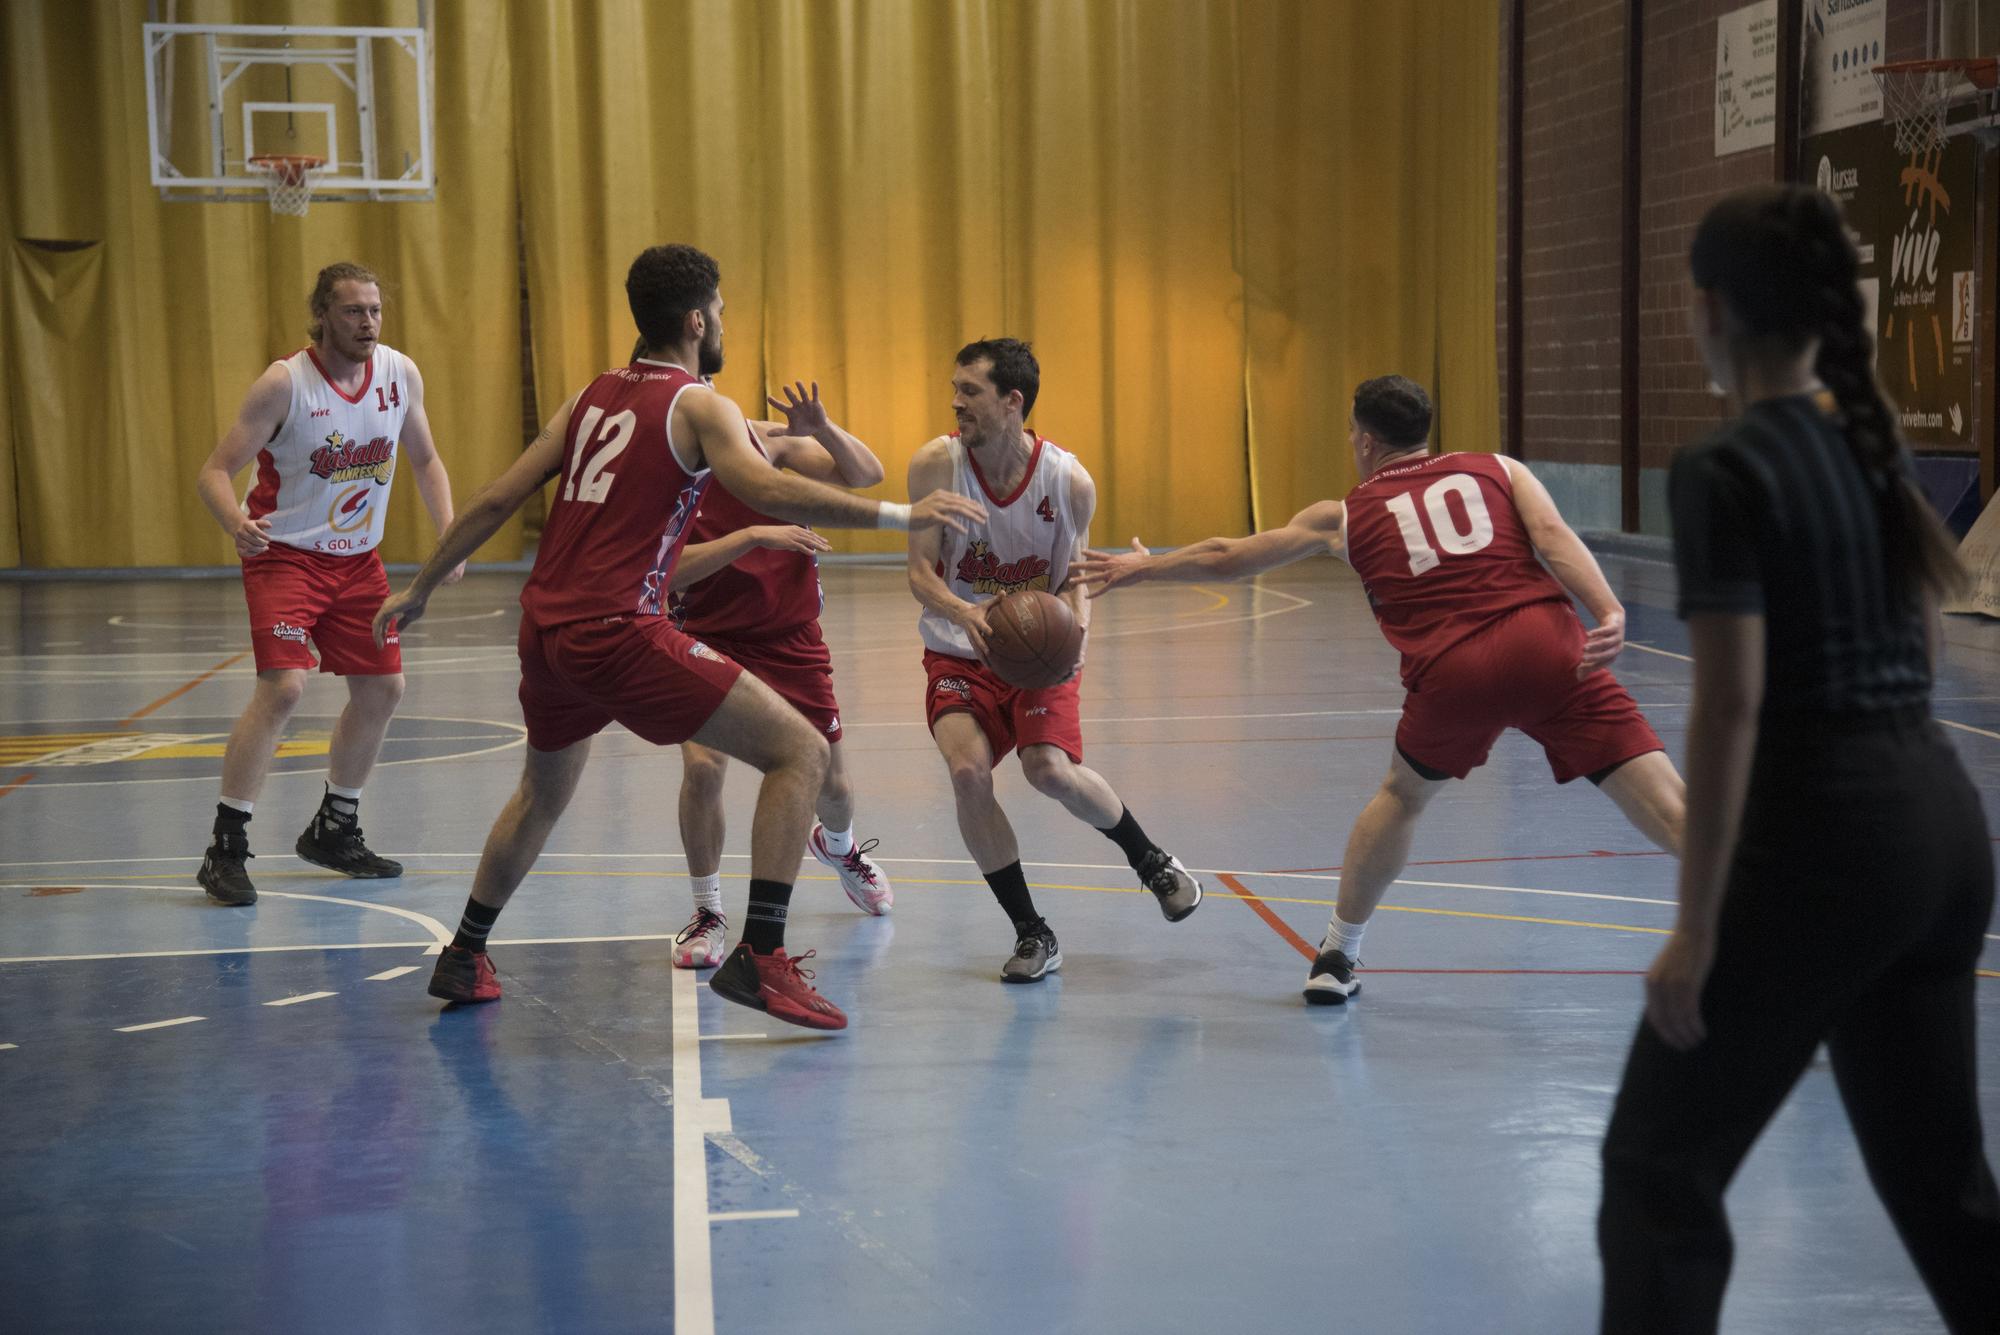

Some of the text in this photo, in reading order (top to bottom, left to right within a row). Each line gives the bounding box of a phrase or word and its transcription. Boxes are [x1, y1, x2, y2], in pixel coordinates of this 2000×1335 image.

[1890, 208, 1941, 288] vive
[375, 382, 400, 412] 14
[311, 408, 331, 418] vive
[563, 405, 637, 504] 12
[1036, 495, 1055, 522] 4
[1385, 473, 1494, 577] 10
[314, 537, 369, 551] S. GOL SL
[1025, 705, 1048, 717] vive
